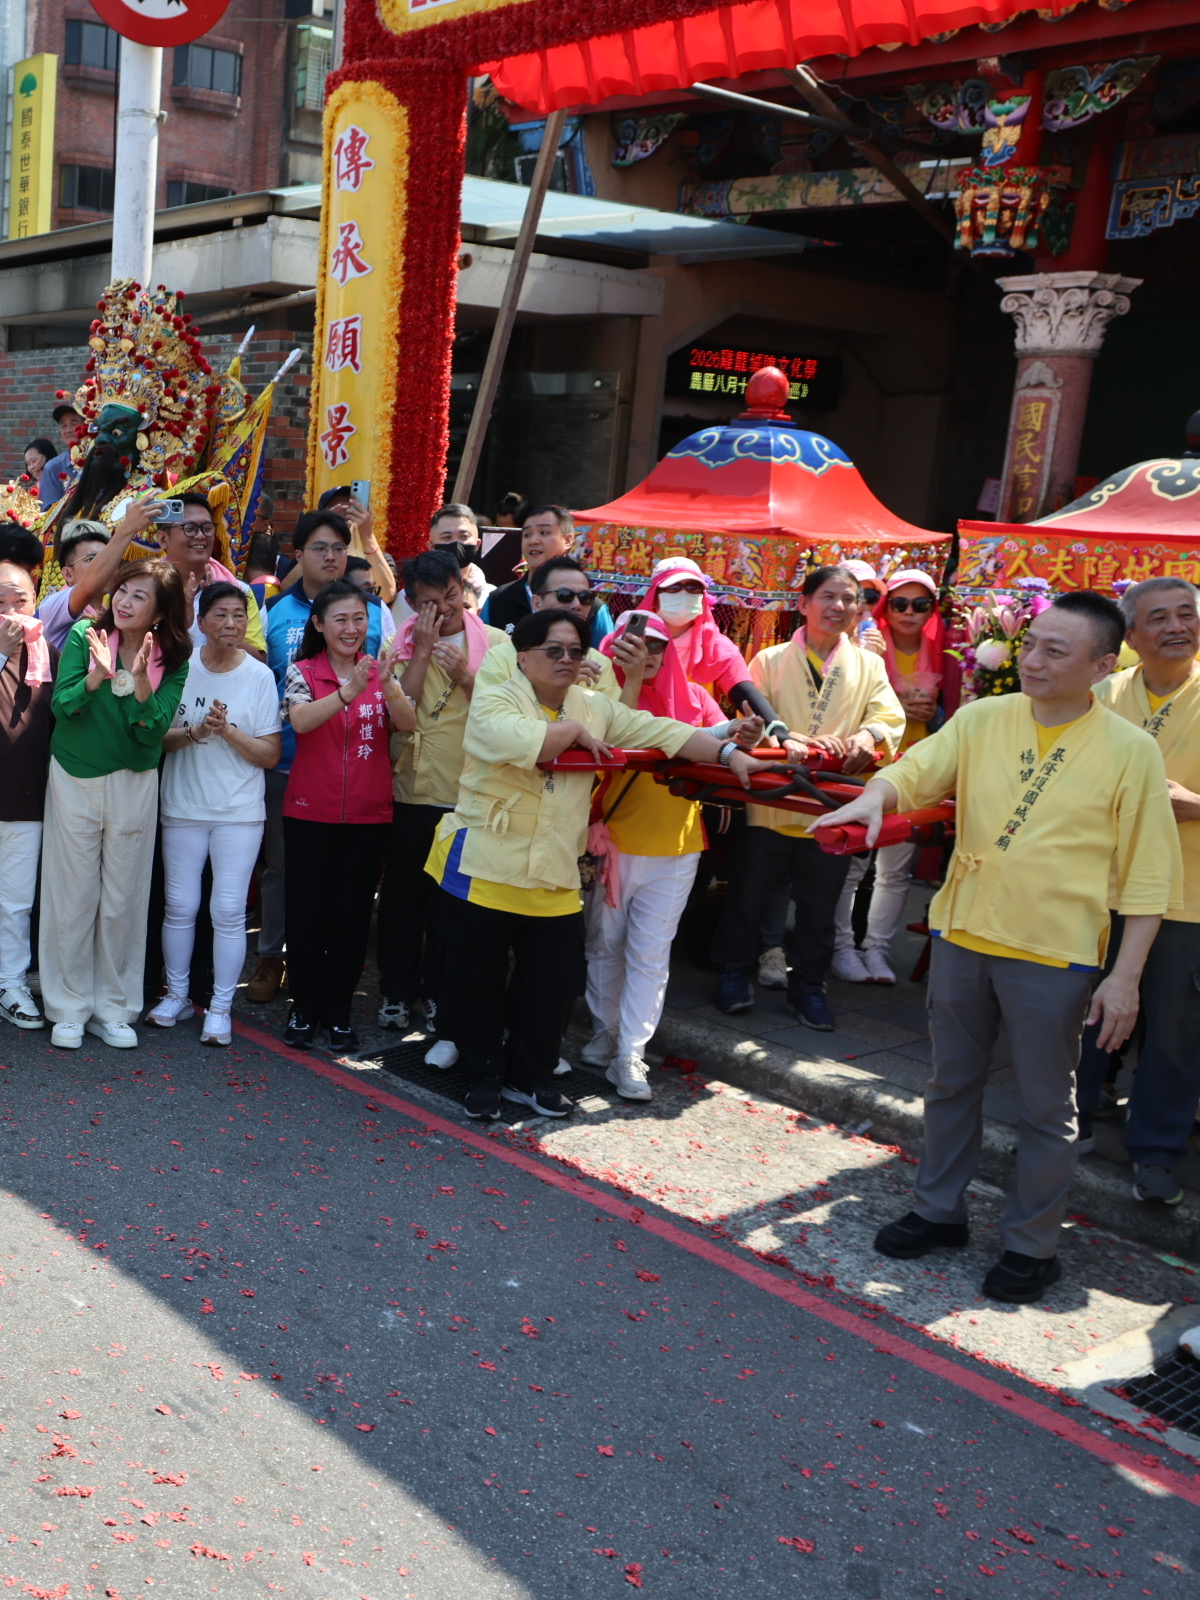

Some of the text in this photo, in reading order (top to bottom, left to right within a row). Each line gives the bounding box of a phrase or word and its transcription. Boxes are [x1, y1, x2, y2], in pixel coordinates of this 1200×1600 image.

[17, 107, 33, 239] 國泰世華銀行
[319, 127, 374, 467] 傳承願景
[195, 697, 206, 707] N
[358, 703, 374, 761] 鄭愷玲
[373, 690, 385, 728] 市議員
[994, 747, 1066, 852] 基隆護國城隍廟
